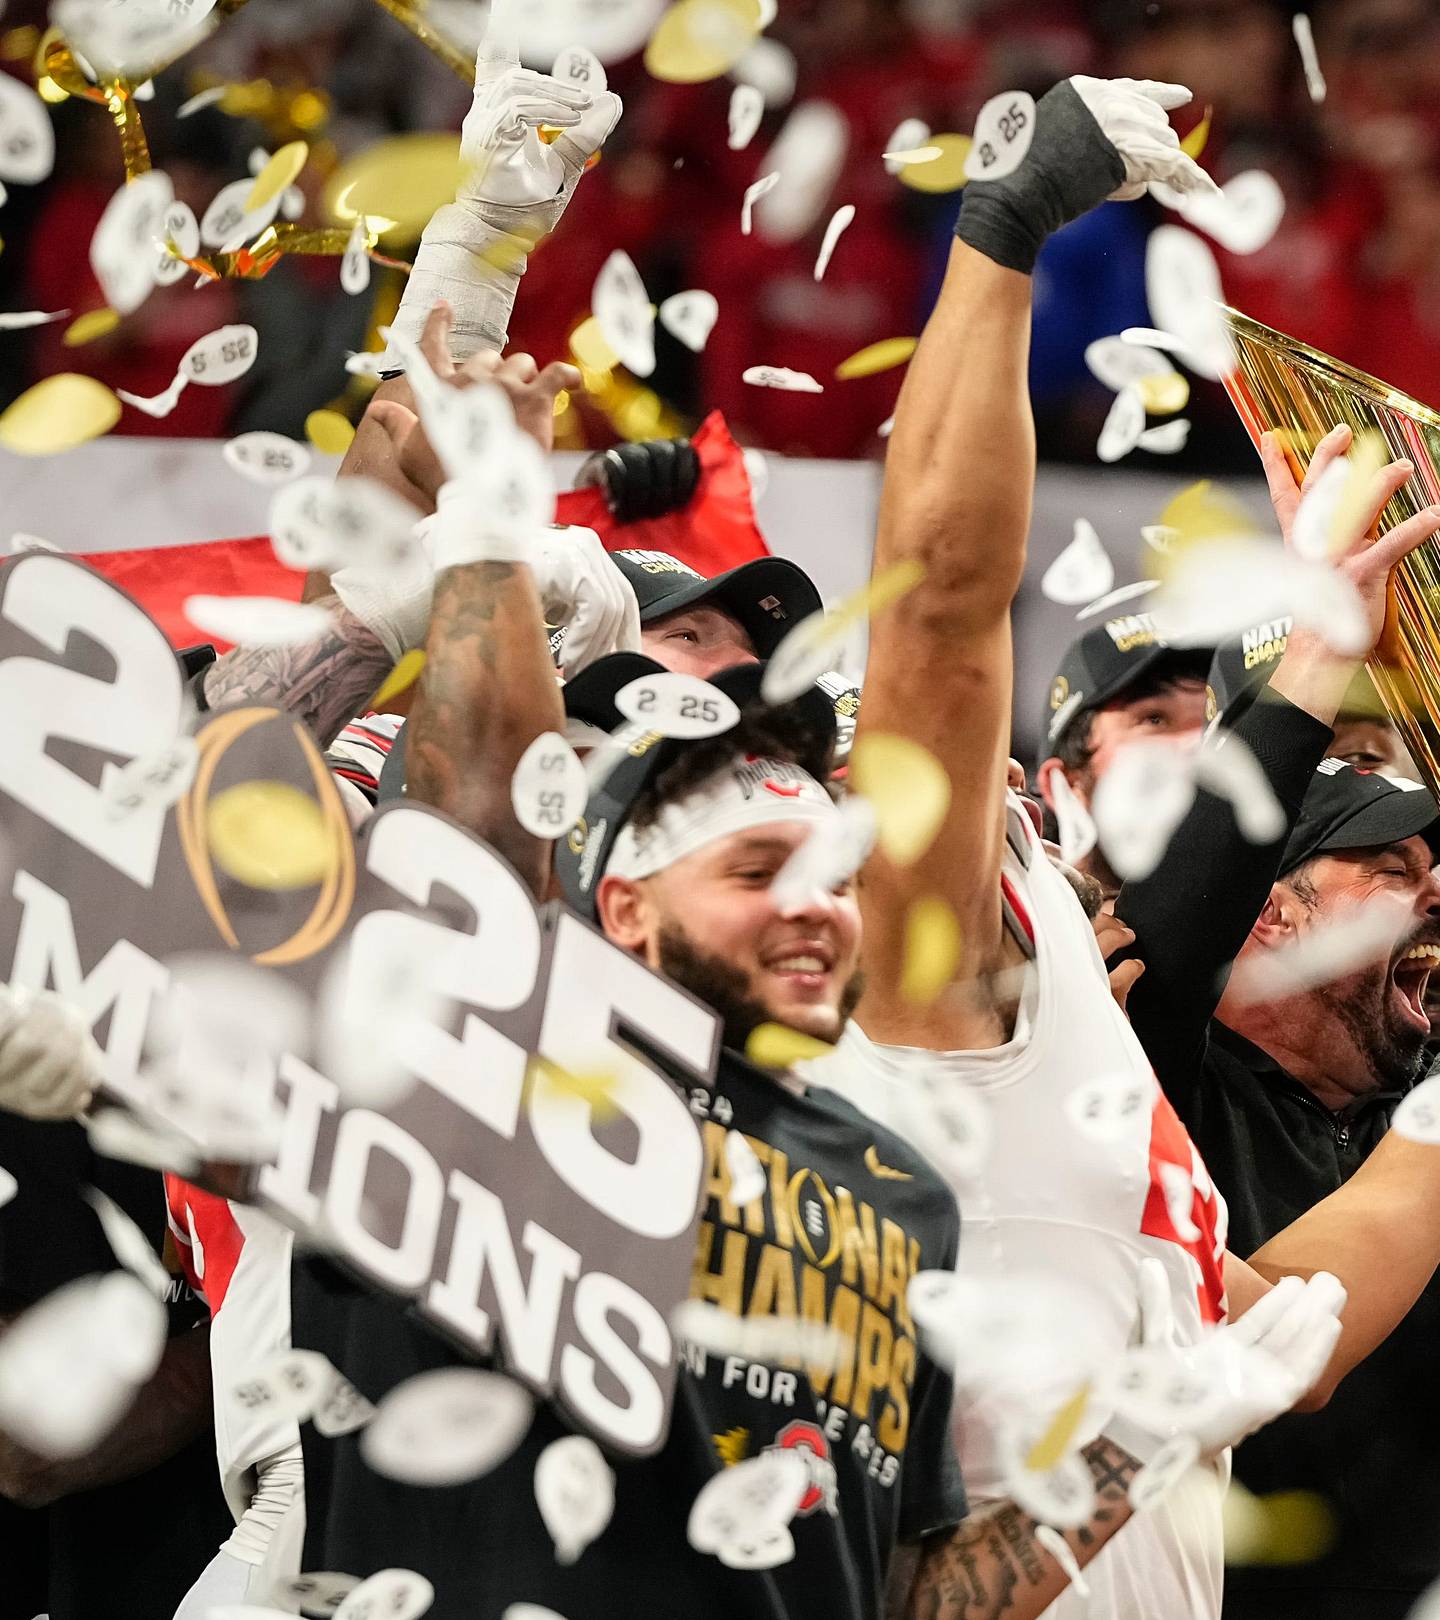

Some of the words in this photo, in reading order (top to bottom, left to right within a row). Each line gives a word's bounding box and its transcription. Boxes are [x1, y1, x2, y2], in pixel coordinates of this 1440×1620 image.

[999, 103, 1027, 142] 25
[638, 688, 656, 713] 2
[680, 694, 719, 723] 25
[348, 808, 718, 1240] 25
[722, 1356, 799, 1407] FOR
